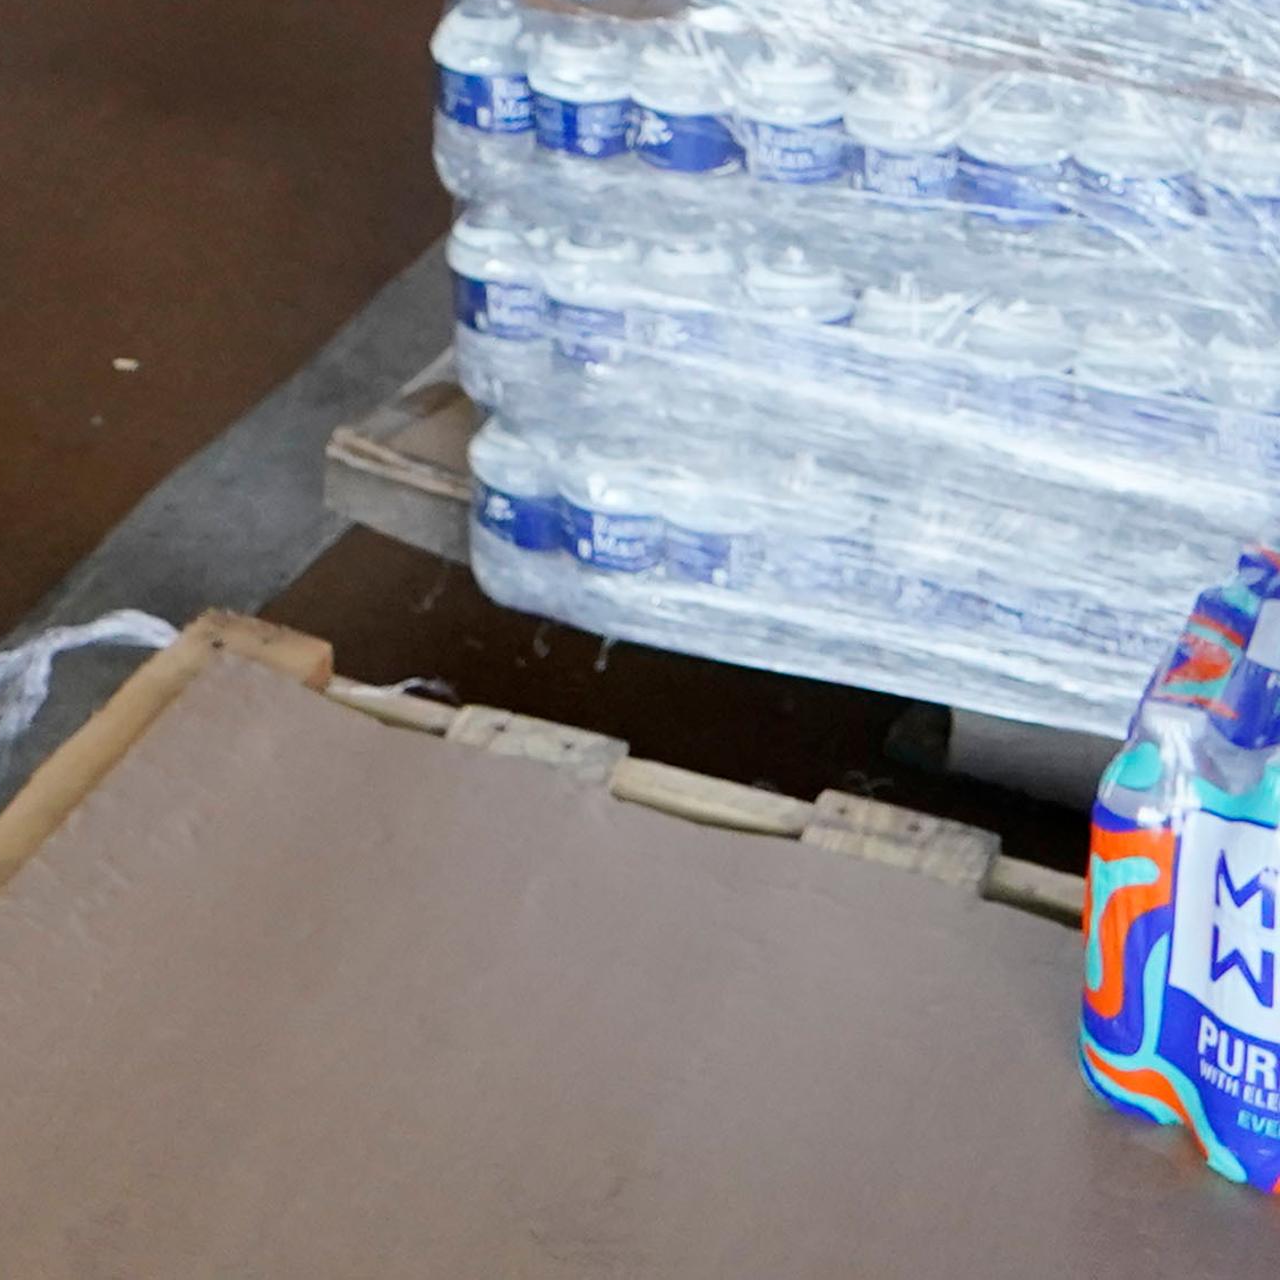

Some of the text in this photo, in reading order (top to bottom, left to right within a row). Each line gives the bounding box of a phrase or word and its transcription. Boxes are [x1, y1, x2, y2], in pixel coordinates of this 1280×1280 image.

[1197, 1014, 1278, 1090] PUR
[1199, 1058, 1280, 1113] WITH ELE
[1236, 1108, 1280, 1140] EVE
